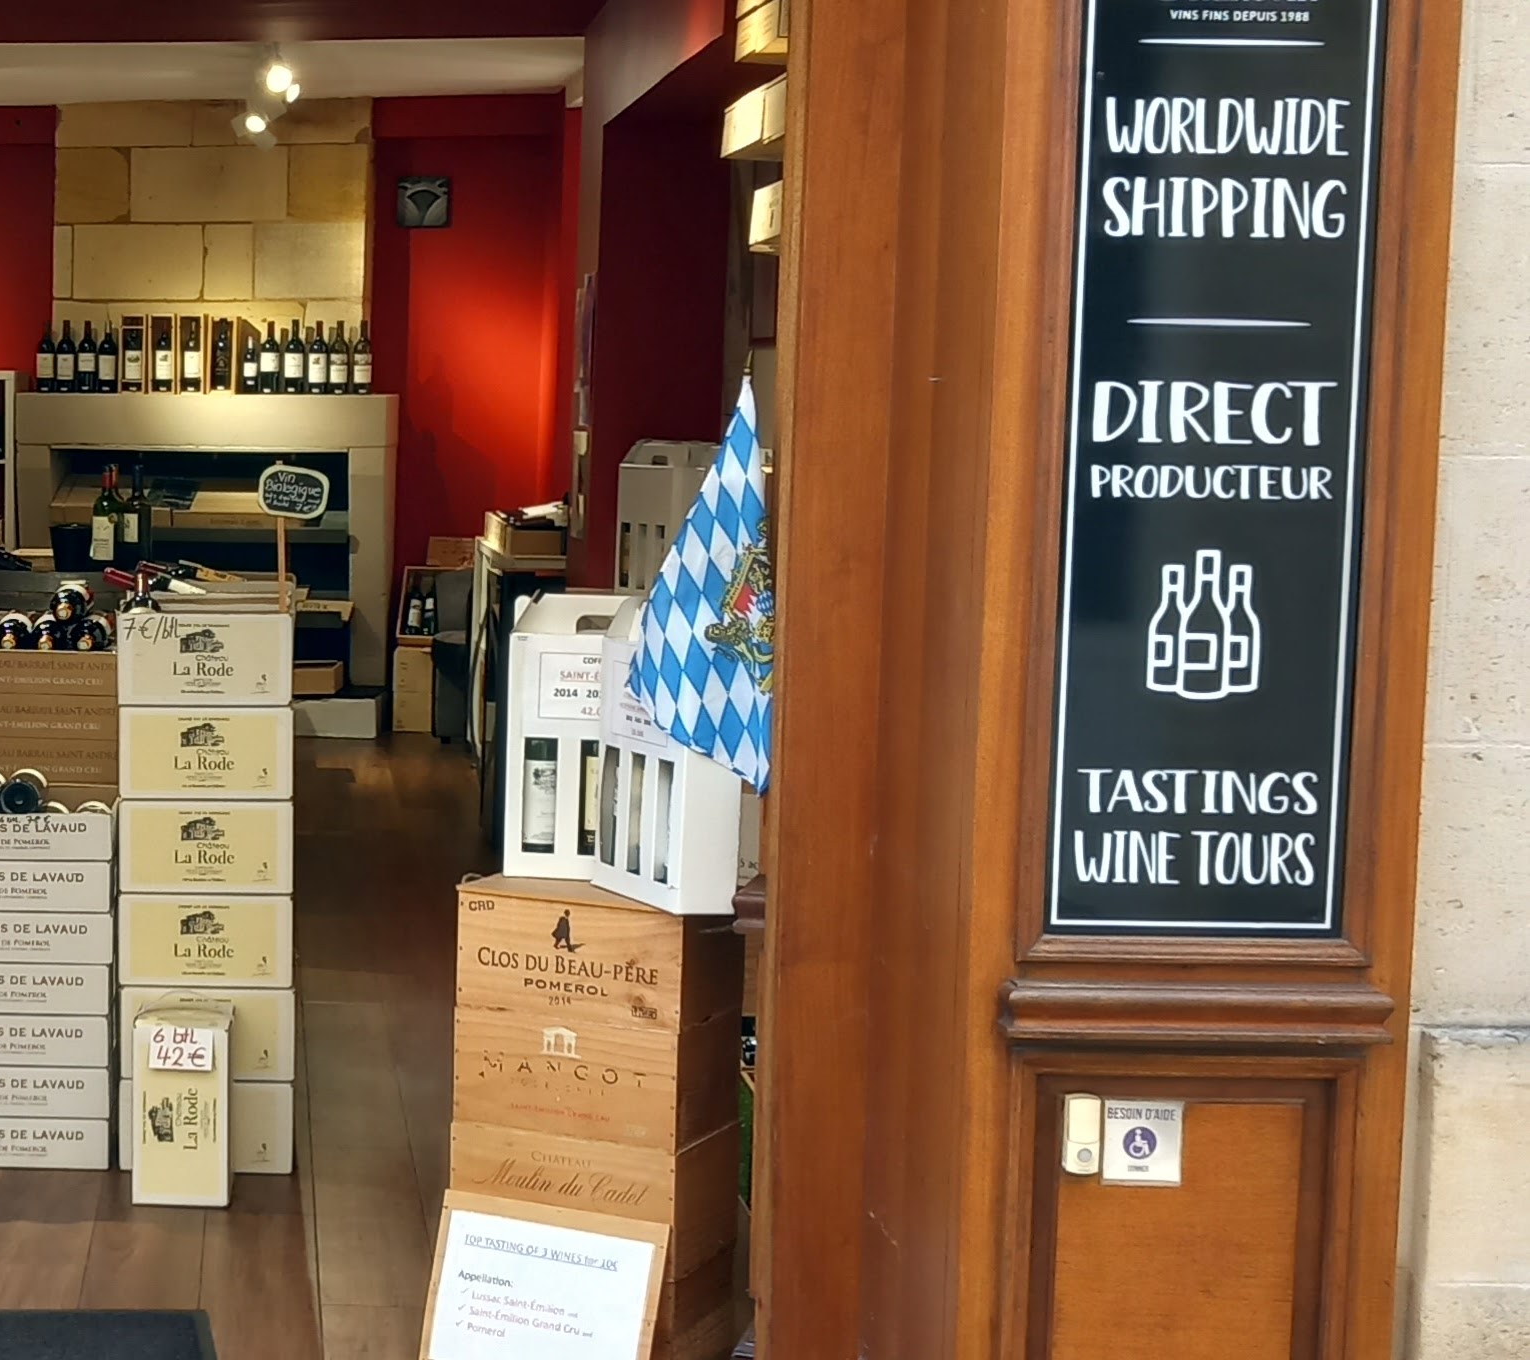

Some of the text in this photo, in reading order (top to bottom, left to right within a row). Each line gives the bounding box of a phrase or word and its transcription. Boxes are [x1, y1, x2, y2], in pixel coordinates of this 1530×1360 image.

[1169, 9, 1310, 22] VINS FINS DEPUIS 1988
[1106, 97, 1350, 155] WORLDWIDE
[1103, 177, 1346, 238] SHIPPING
[1093, 381, 1337, 445] DIRECT
[278, 472, 296, 483] Vin
[1091, 465, 1331, 499] PRODUCTEUR
[173, 662, 234, 677] La Rode
[53, 677, 84, 685] GRAND
[86, 678, 104, 686] CRU
[553, 688, 579, 698] 2014
[50, 722, 82, 730] GRAND
[83, 723, 102, 731] CRU
[174, 755, 235, 771] La Rode
[1078, 769, 1317, 814] TASTINGS
[13, 823, 30, 833] DE
[35, 823, 87, 833] LAVAUD
[174, 849, 235, 864] La Rode
[1075, 831, 1314, 885] WINE TOURS
[10, 872, 27, 882] DE
[32, 872, 85, 882] LAVAUD
[469, 900, 495, 911] CRD
[13, 924, 30, 934] DE
[35, 924, 88, 934] LAVAUD
[174, 943, 235, 959] La Rode
[477, 946, 659, 986] CLOS DU BEAU-PÈRE
[9, 976, 27, 985] DE
[32, 977, 84, 986] LAVAUD
[524, 978, 608, 997] POMEROL
[9, 1027, 26, 1037] DE
[31, 1028, 83, 1038] LAVAUD
[153, 1027, 198, 1044] 6 btl
[156, 1045, 207, 1067] 42€
[11, 1078, 28, 1088] DE
[33, 1079, 85, 1089] LAVAUD
[183, 1087, 198, 1150] La Rode
[1107, 1107, 1176, 1121] BESOIN D'AIDE
[10, 1130, 28, 1140] DE
[32, 1130, 85, 1140] LAVAUD
[471, 1157, 554, 1193] Moulin
[558, 1172, 584, 1197] du
[465, 1233, 483, 1246] TOP
[484, 1236, 524, 1254] TASTING
[550, 1248, 582, 1265] WINES
[458, 1269, 513, 1289] Appellation:
[471, 1290, 501, 1304] Lussac
[503, 1295, 565, 1315] Saint-Émilion
[469, 1305, 530, 1326] Saint-Émilion
[532, 1316, 561, 1332] Grand
[563, 1322, 581, 1336] Cru
[467, 1322, 506, 1338] Pomerol
